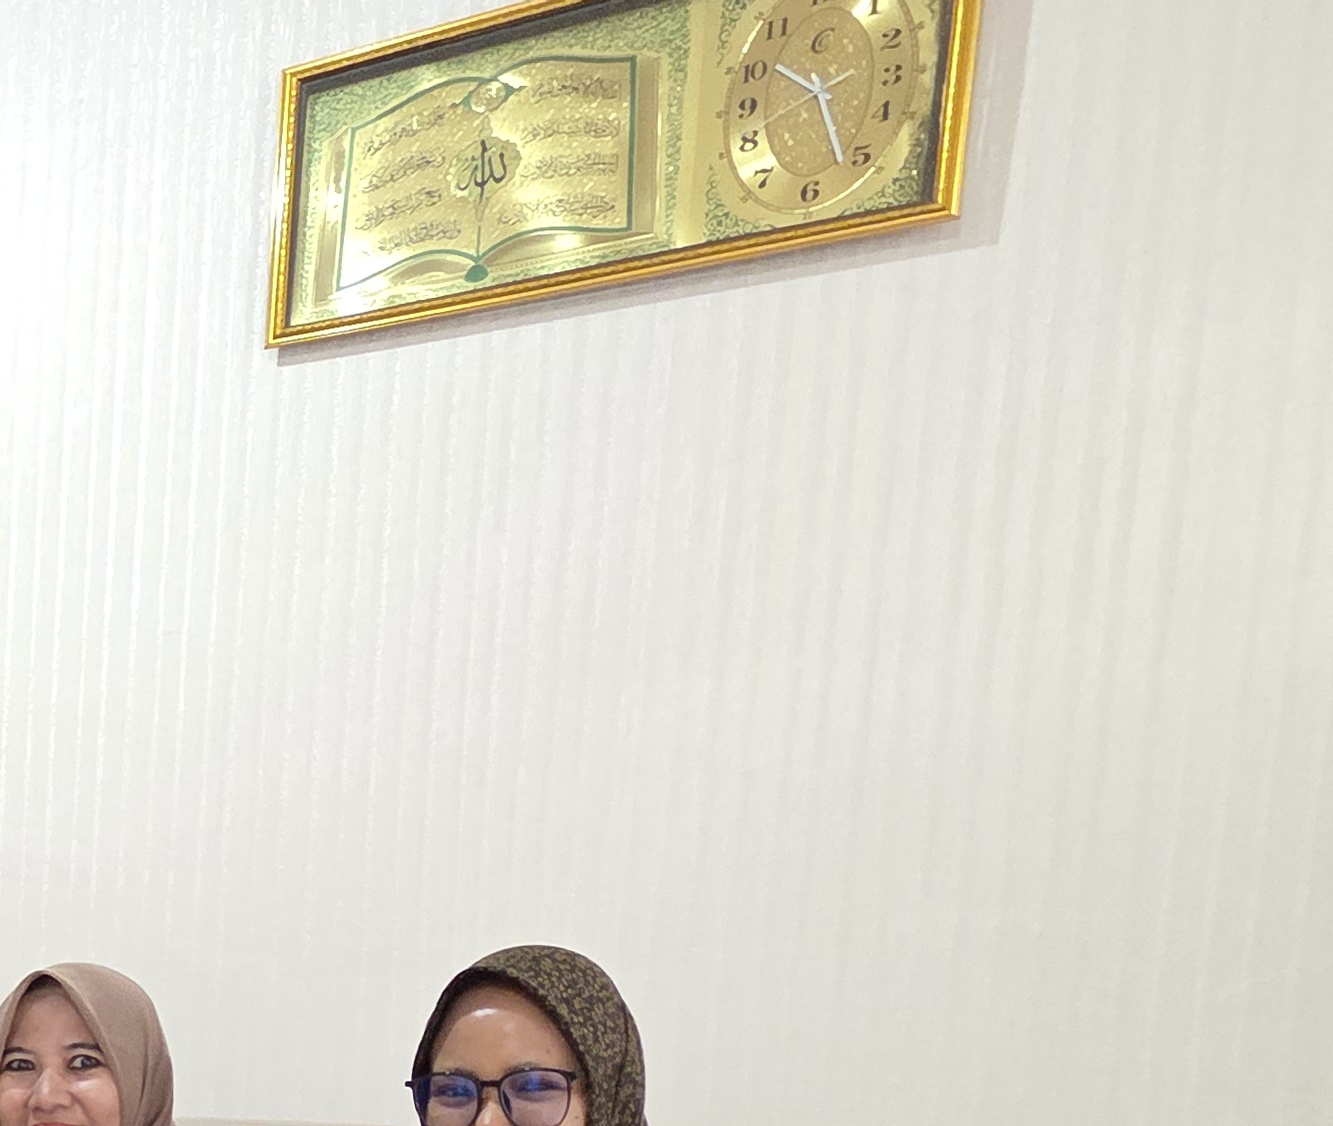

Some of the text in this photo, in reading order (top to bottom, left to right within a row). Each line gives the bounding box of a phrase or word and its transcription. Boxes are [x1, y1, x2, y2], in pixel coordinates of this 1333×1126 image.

[766, 17, 789, 41] 11
[881, 28, 902, 50] 2
[743, 60, 768, 84] 10
[881, 64, 902, 86] 3
[738, 97, 758, 119] 9
[871, 100, 890, 122] 4
[739, 130, 758, 152] 8
[851, 143, 872, 167] 5
[754, 166, 774, 188] 7
[800, 181, 820, 202] 6
